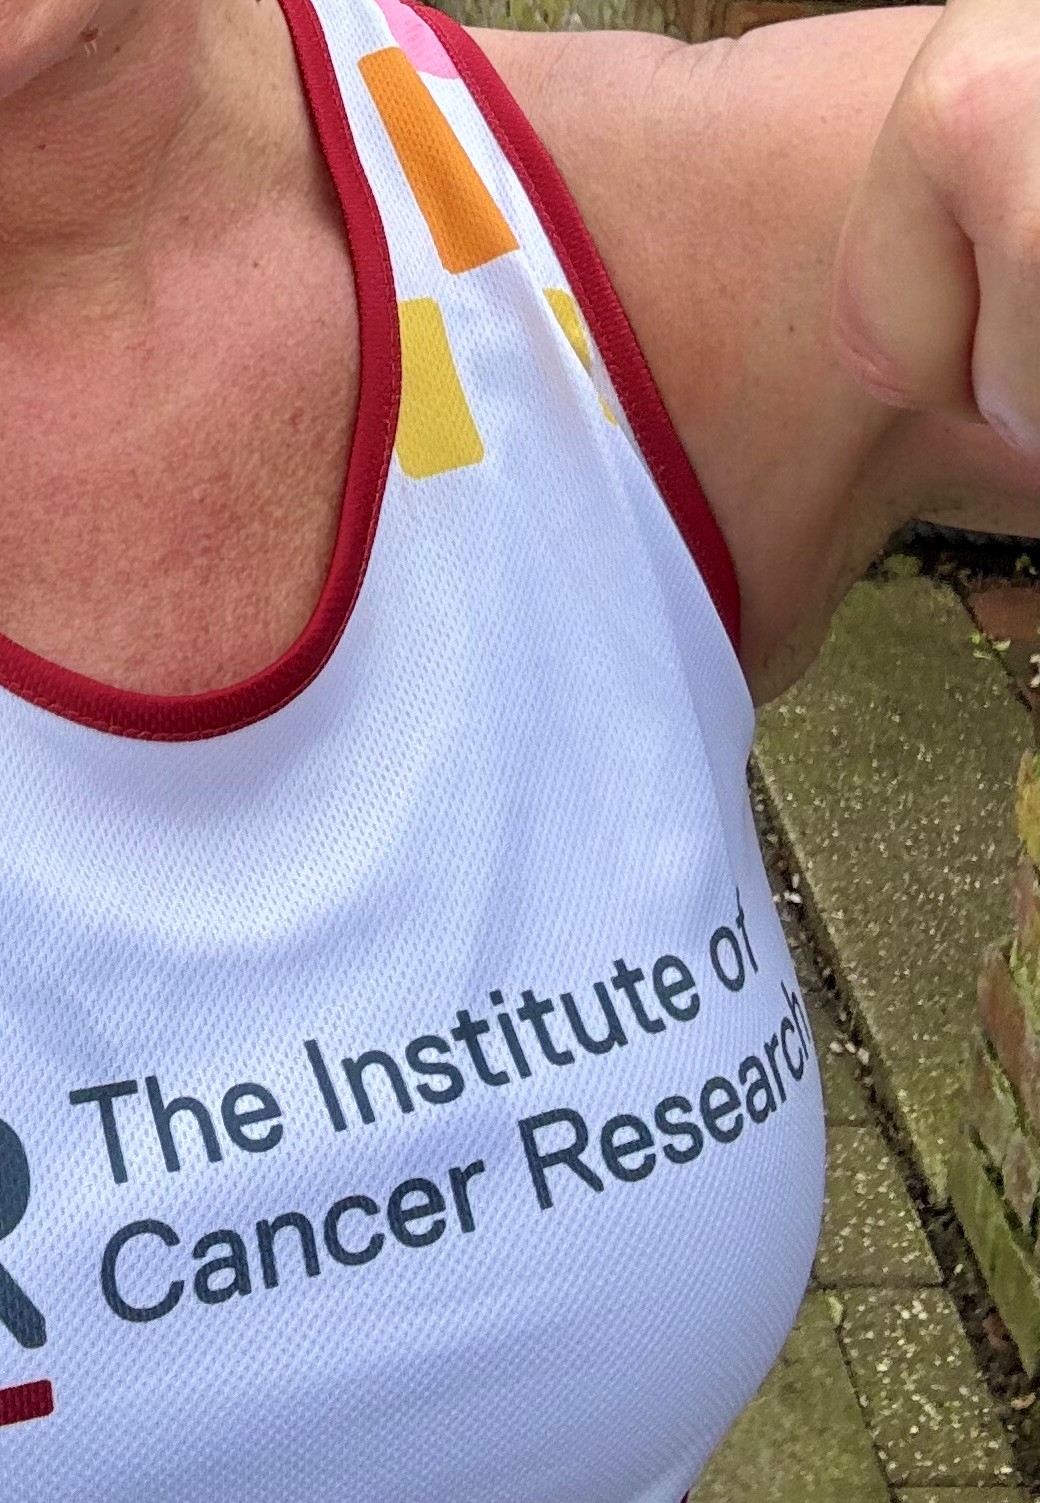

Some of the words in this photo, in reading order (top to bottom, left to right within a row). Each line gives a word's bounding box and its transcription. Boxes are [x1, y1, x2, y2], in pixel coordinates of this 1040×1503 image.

[68, 1075, 283, 1184] The
[304, 955, 700, 1132] Institute
[709, 885, 759, 992] of
[100, 1159, 486, 1323] Cancer
[517, 980, 812, 1210] Research
